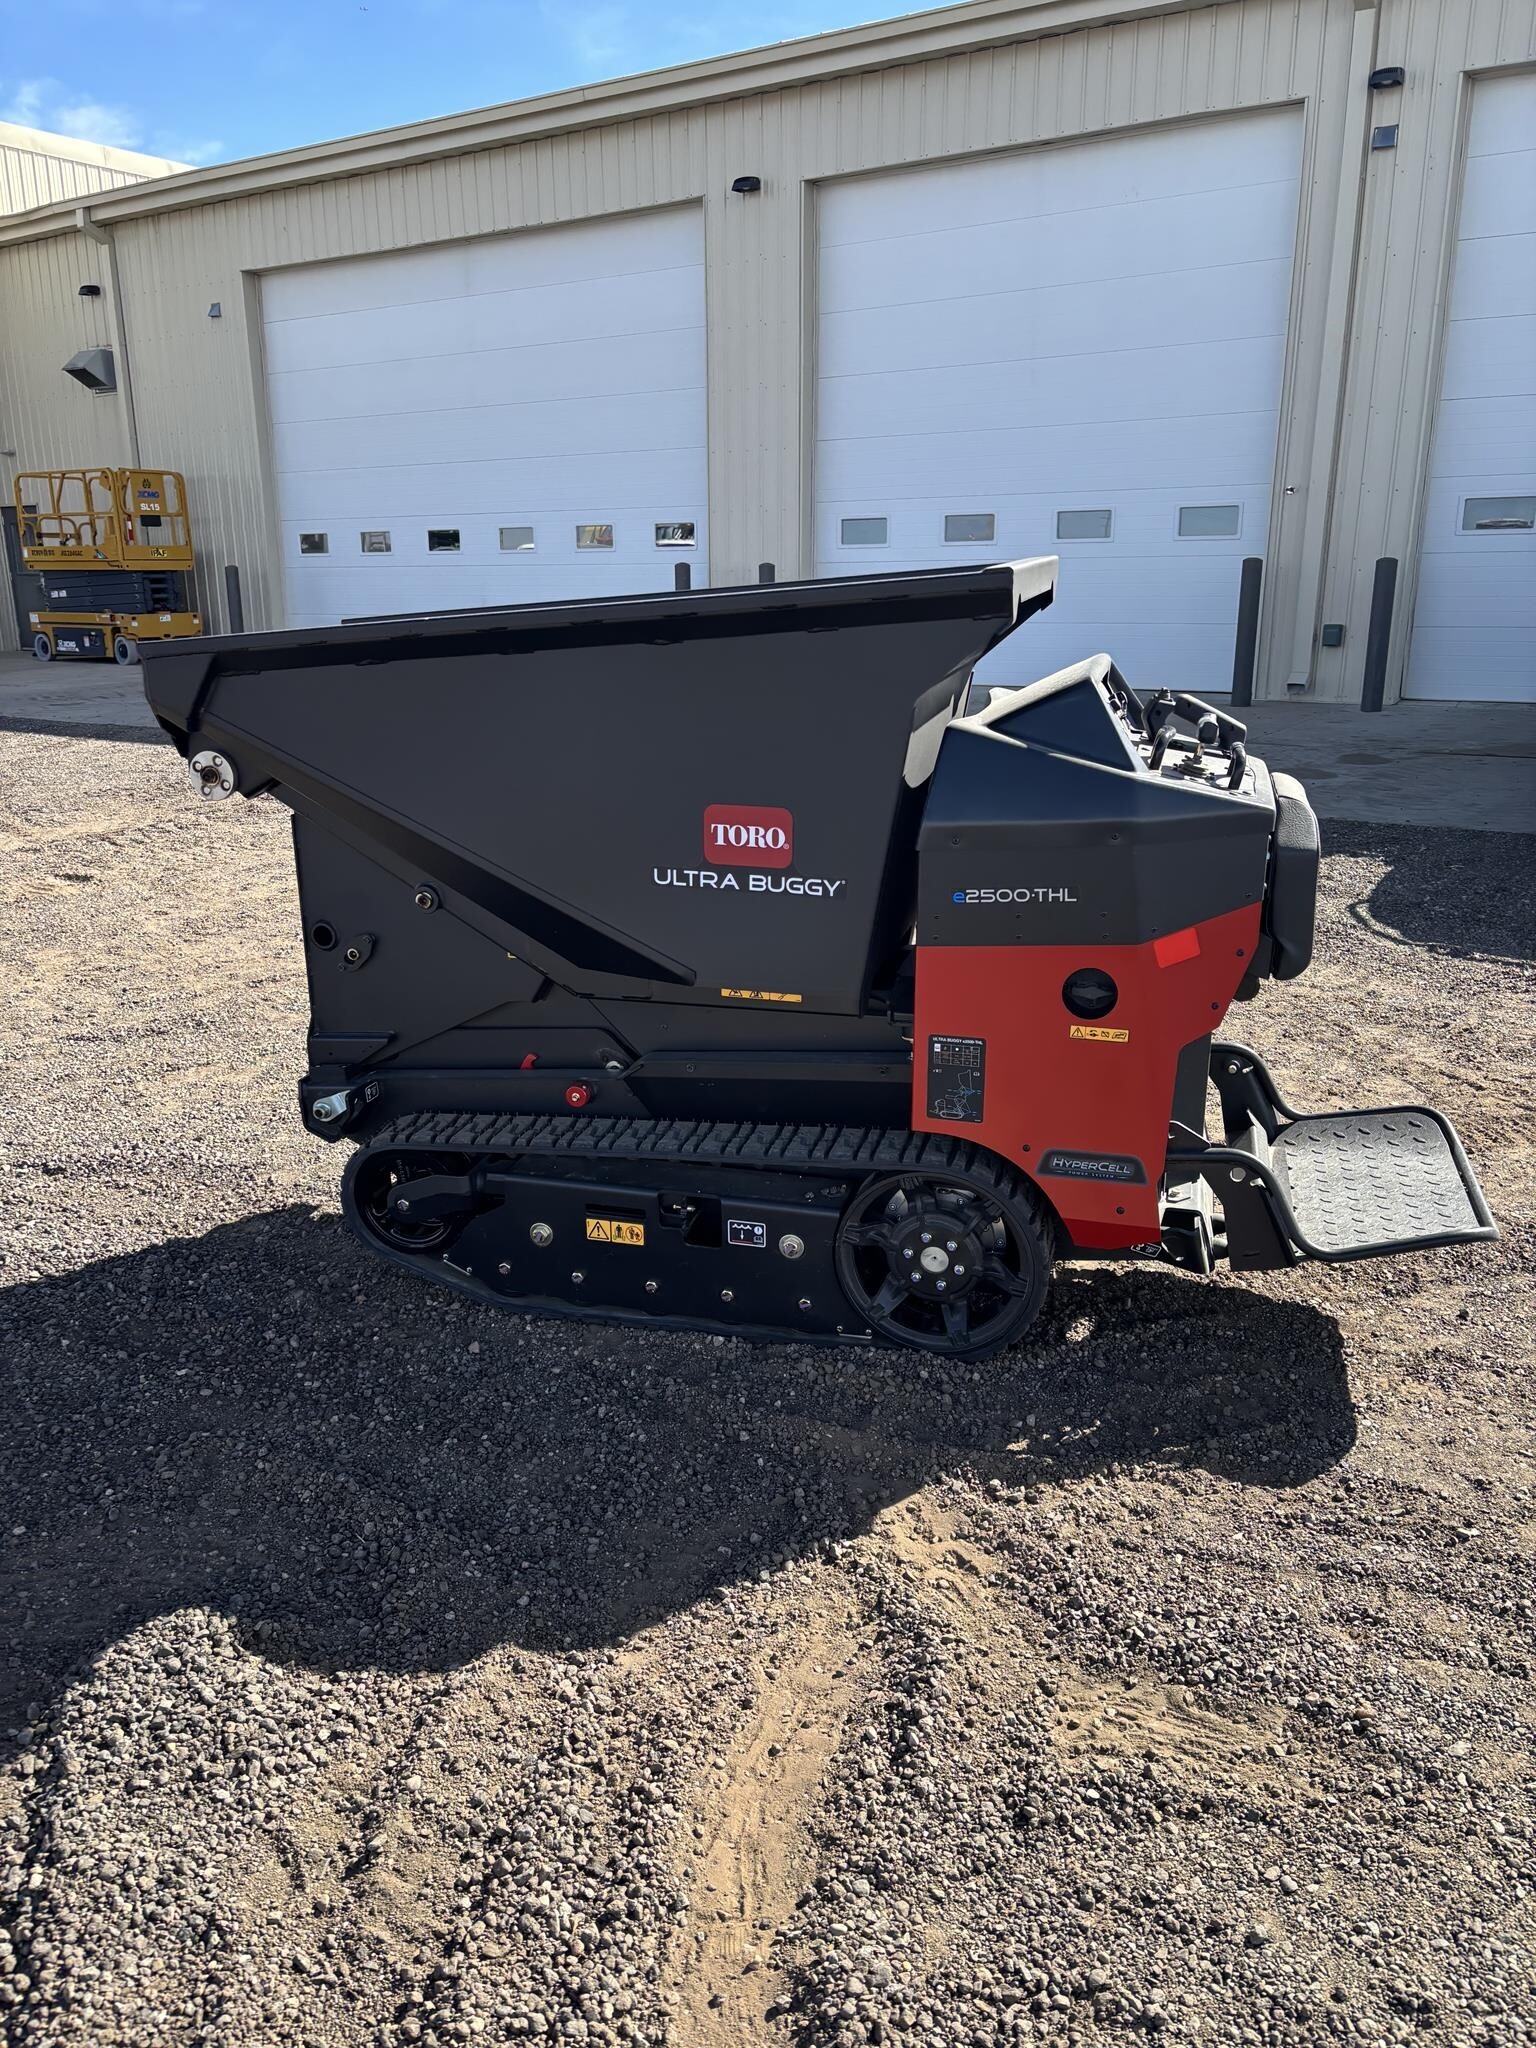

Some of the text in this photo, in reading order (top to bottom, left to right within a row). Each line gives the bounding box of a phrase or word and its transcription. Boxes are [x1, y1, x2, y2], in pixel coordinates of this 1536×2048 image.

[137, 490, 160, 498] XCMG
[140, 503, 160, 511] SL15
[711, 824, 786, 849] TORO
[653, 868, 842, 897] ULTRA BUGGY
